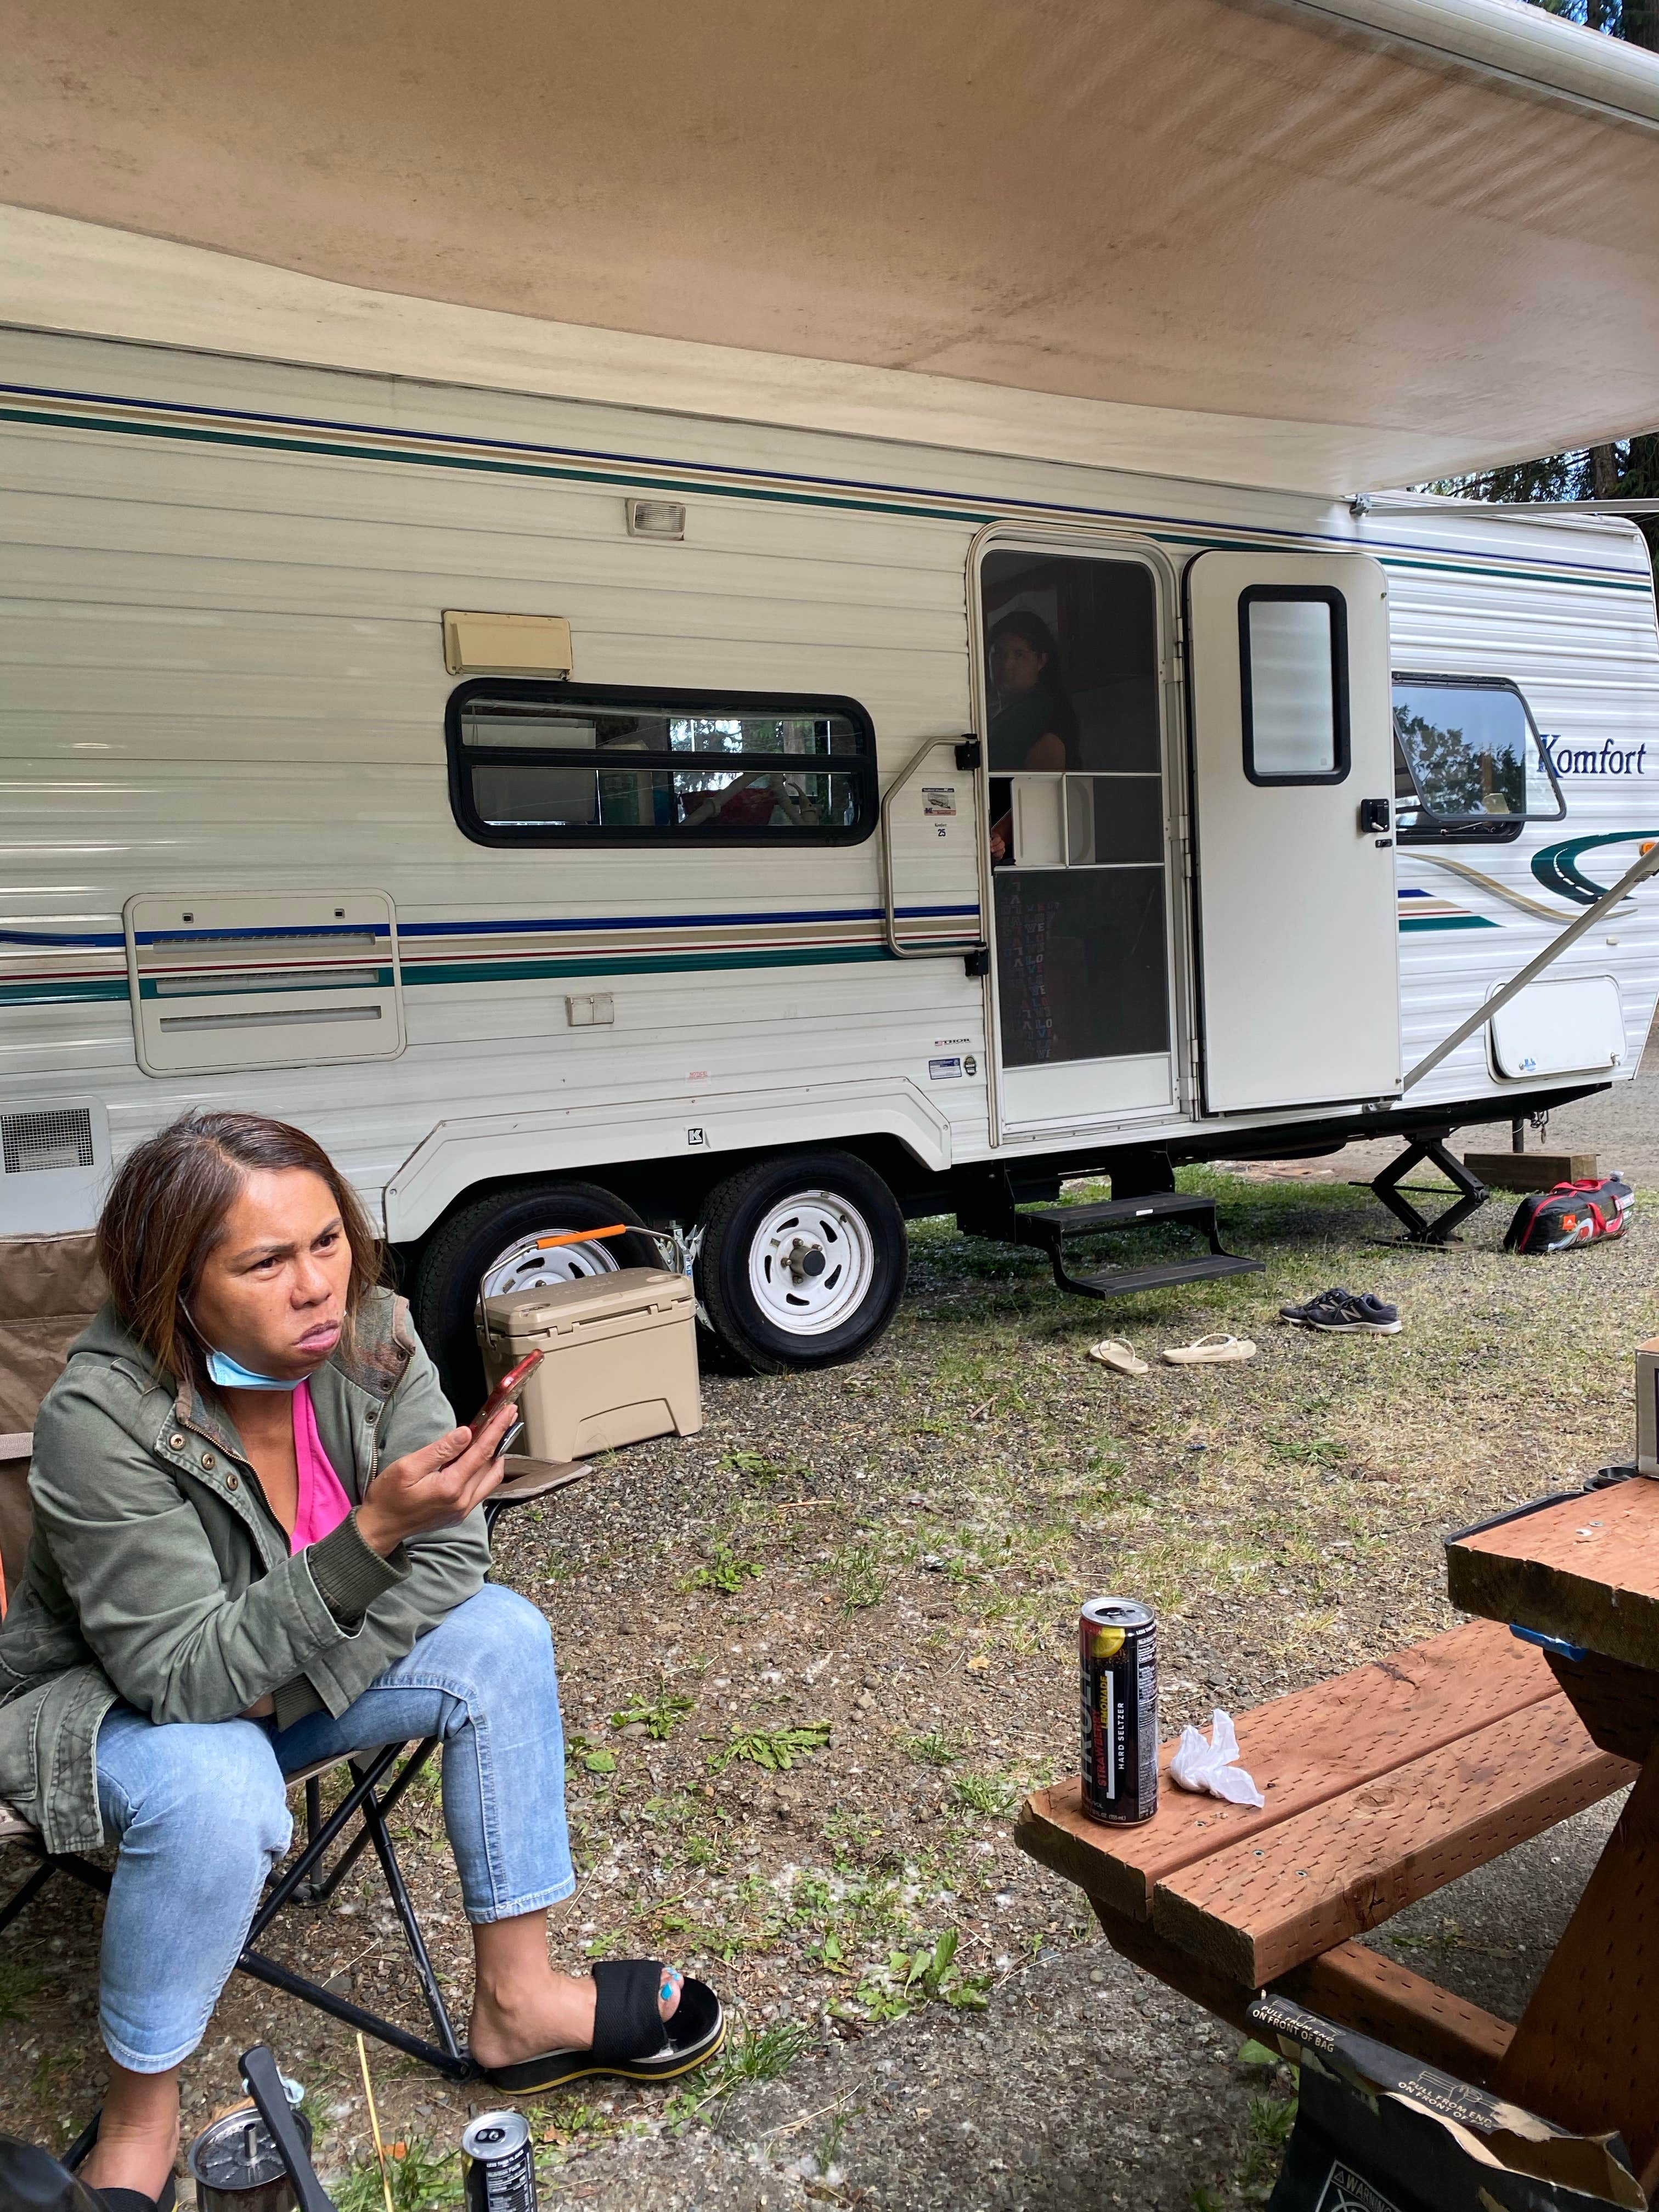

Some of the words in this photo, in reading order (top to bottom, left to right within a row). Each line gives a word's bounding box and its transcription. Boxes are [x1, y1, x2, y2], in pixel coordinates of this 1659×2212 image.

[1537, 734, 1646, 778] Komfort
[938, 828, 946, 837] 25
[1100, 1676, 1108, 1729] LEMONADE
[1092, 1708, 1107, 1787] STRAWBERRY
[1252, 2010, 1267, 2021] ON
[1267, 2016, 1299, 2035] FRONT
[1301, 2031, 1314, 2042] OF
[1315, 2037, 1335, 2053] BAG
[1261, 2005, 1283, 2019] PULL
[1285, 2017, 1313, 2030] FROM
[1313, 2030, 1334, 2041] END
[1398, 2081, 1415, 2093] ON
[1415, 2092, 1452, 2112] FRONT
[1453, 2111, 1469, 2120] OF
[1408, 2081, 1432, 2096] PULL
[1436, 2095, 1467, 2113] FROM
[1469, 2111, 1492, 2124] END
